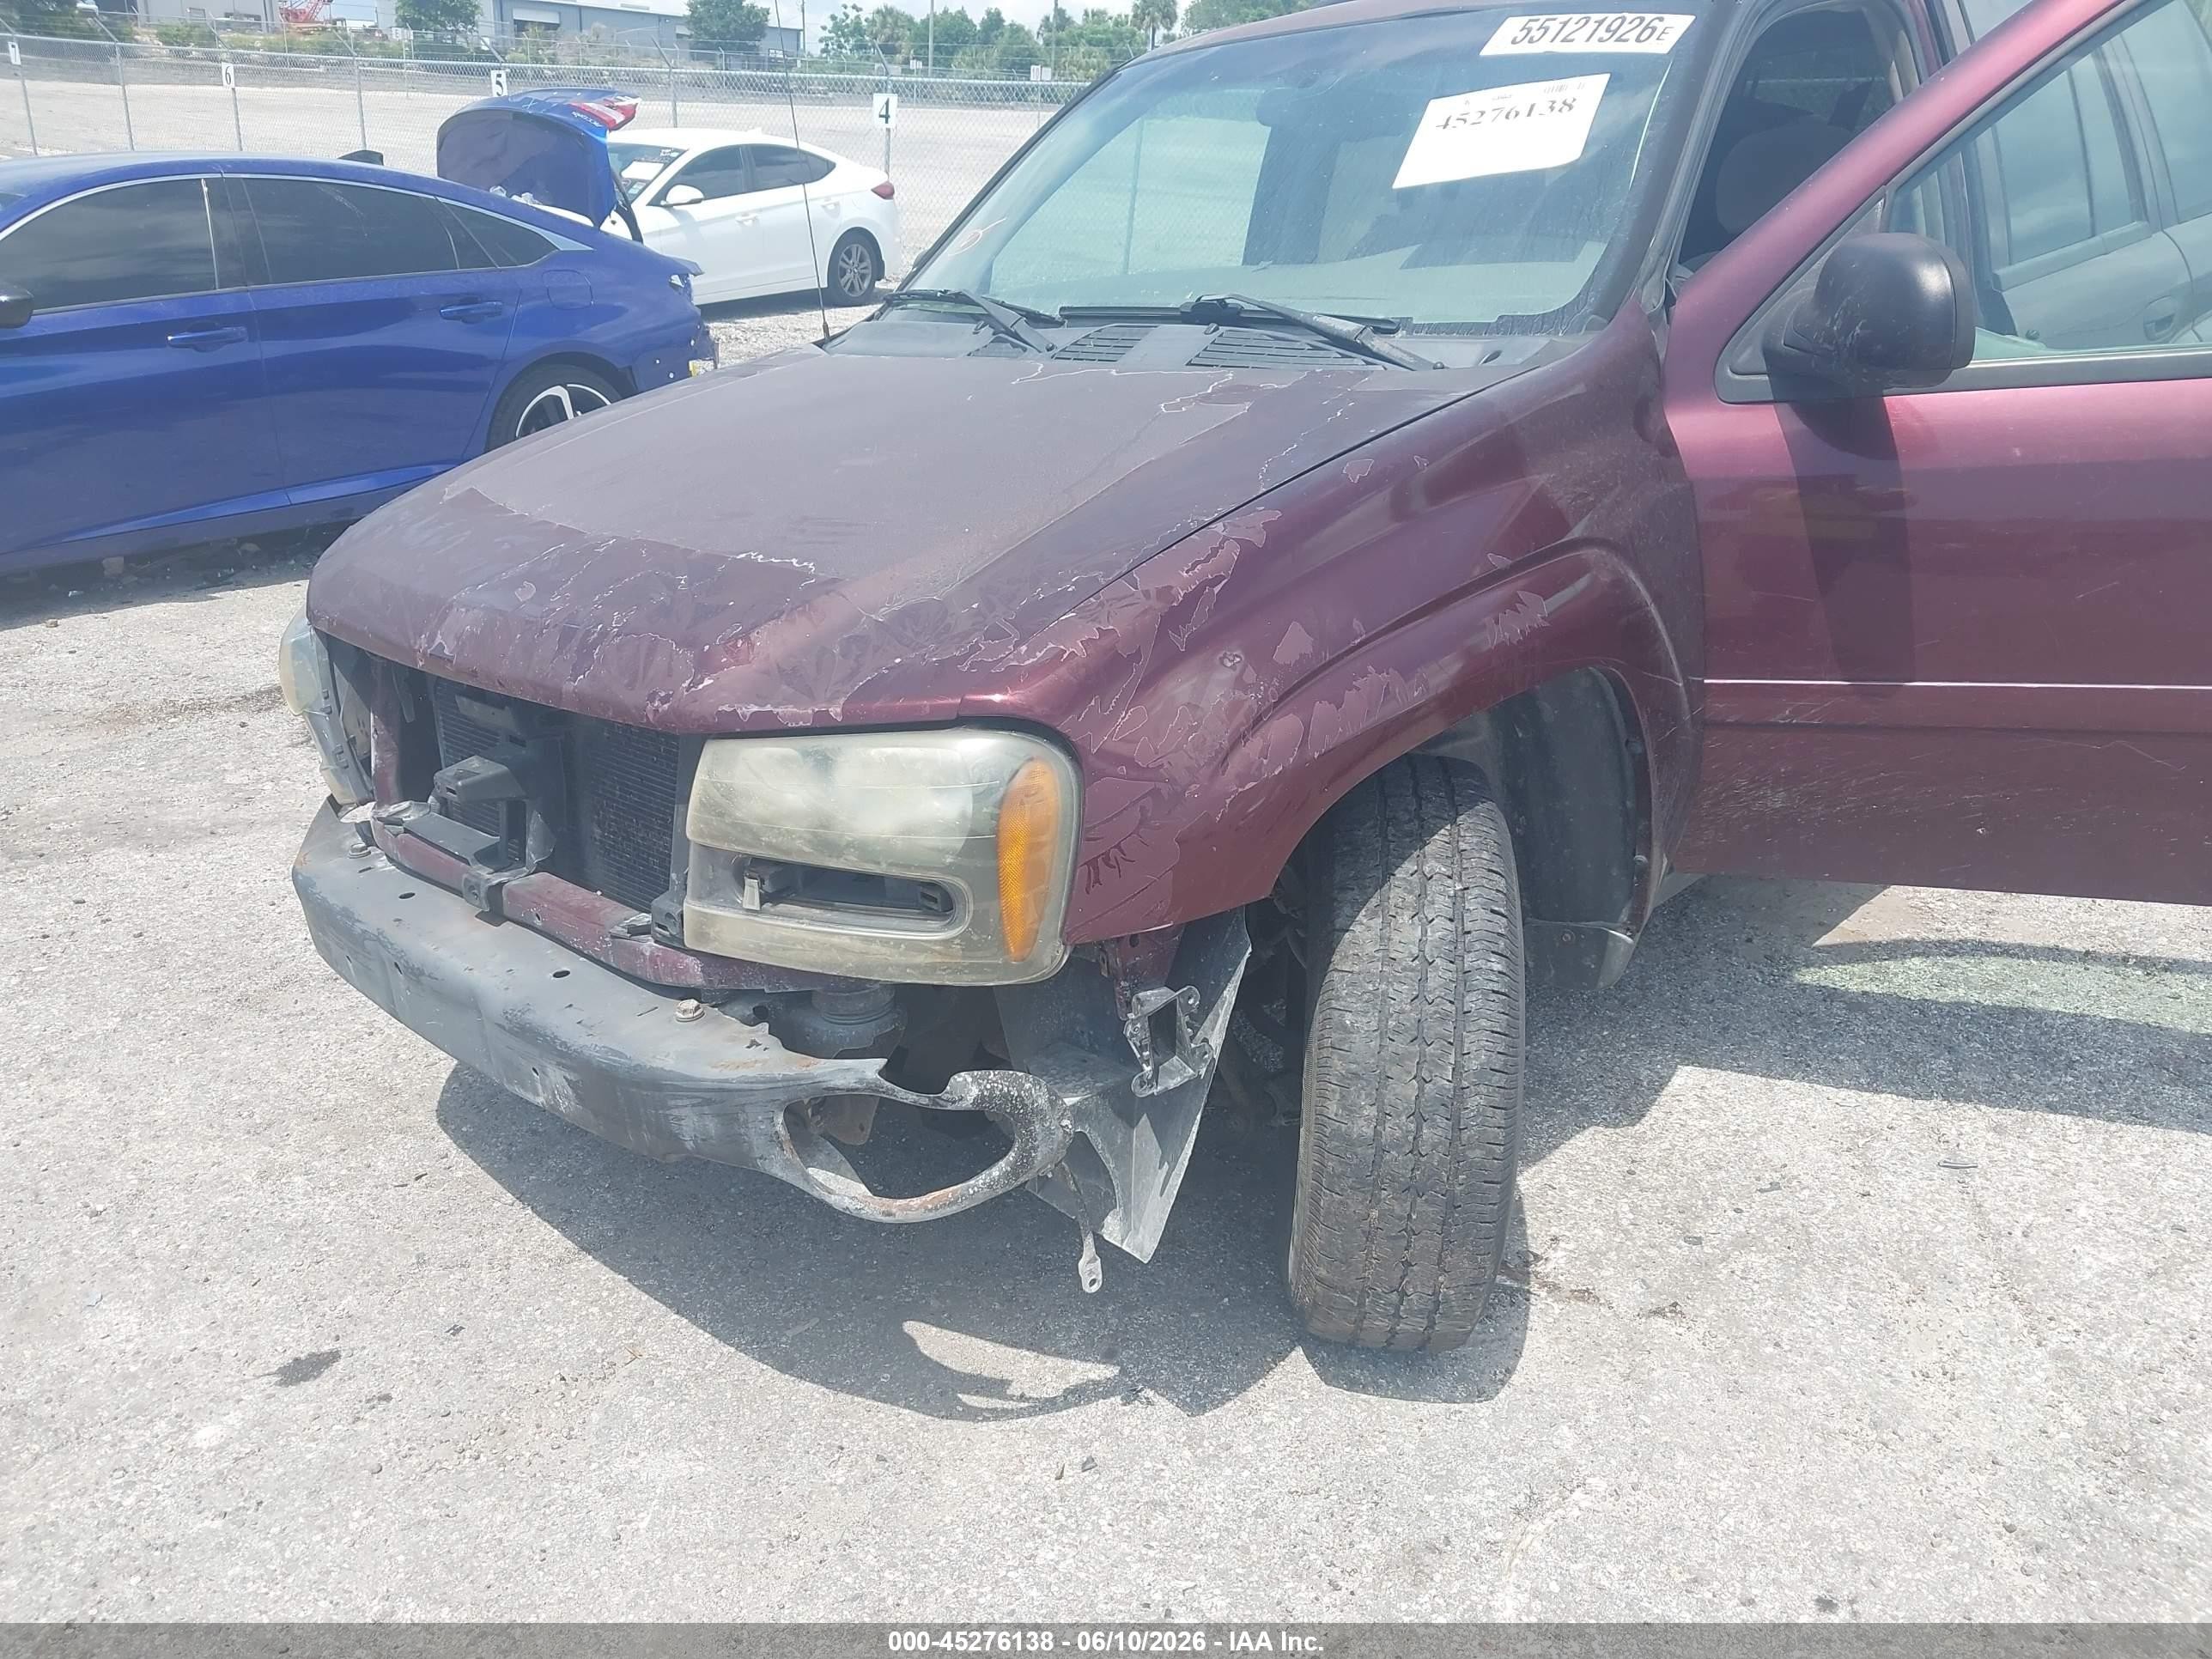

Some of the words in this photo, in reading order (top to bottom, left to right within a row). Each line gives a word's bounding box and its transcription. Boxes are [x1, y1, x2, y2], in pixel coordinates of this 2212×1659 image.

[1510, 15, 1674, 45] 55121926E
[11, 44, 17, 63] 7
[225, 65, 232, 85] 6
[495, 73, 504, 96] 5
[878, 97, 890, 125] 4
[1435, 97, 1577, 130] 45276138
